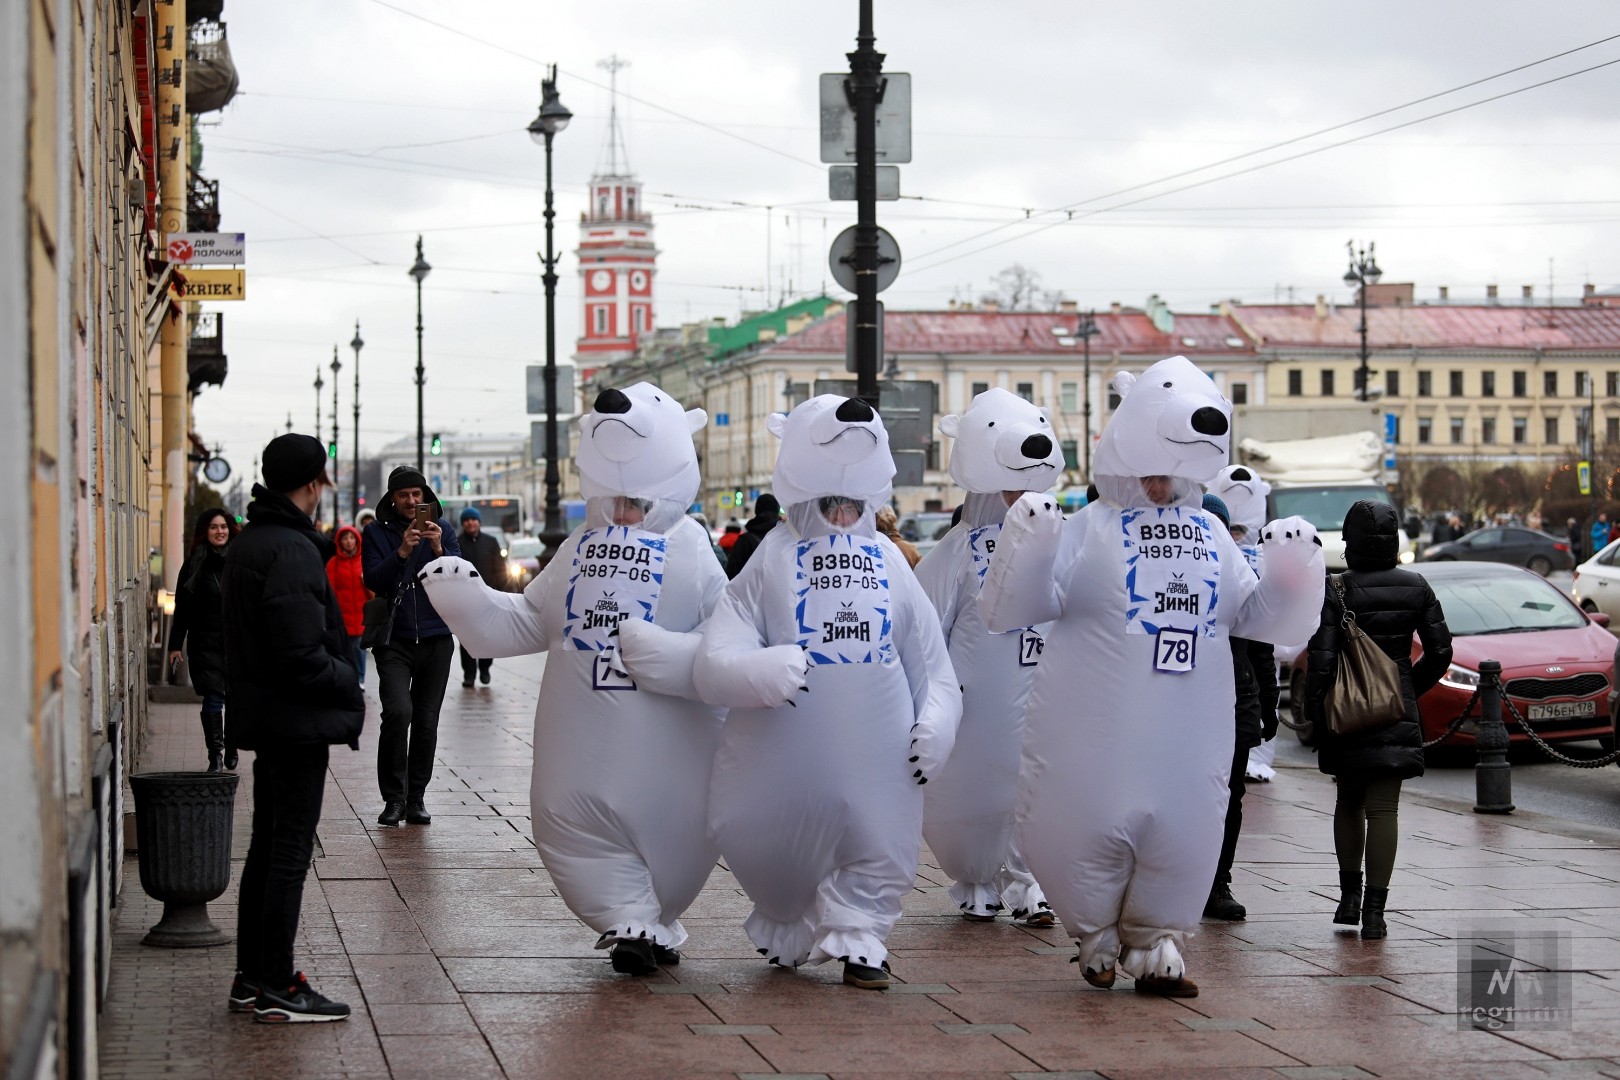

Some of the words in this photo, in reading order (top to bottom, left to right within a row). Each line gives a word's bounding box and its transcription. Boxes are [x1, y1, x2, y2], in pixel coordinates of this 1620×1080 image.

[193, 249, 243, 258] палочки
[186, 284, 233, 295] KRIEK
[1139, 523, 1205, 545] ВЗВОД
[585, 543, 651, 566] ВЗВОД
[1138, 545, 1209, 562] 4987-04
[580, 564, 651, 582] 4987-06
[812, 553, 875, 574] ВЗВОД
[809, 575, 879, 590] 4987-05
[1166, 587, 1189, 595] ГЕРОЕВ
[1168, 581, 1189, 589] ГОНКА
[1153, 591, 1200, 616] ЗИМА
[822, 620, 871, 644] ЗИМА
[1161, 639, 1189, 664] 78
[600, 657, 629, 680] 7
